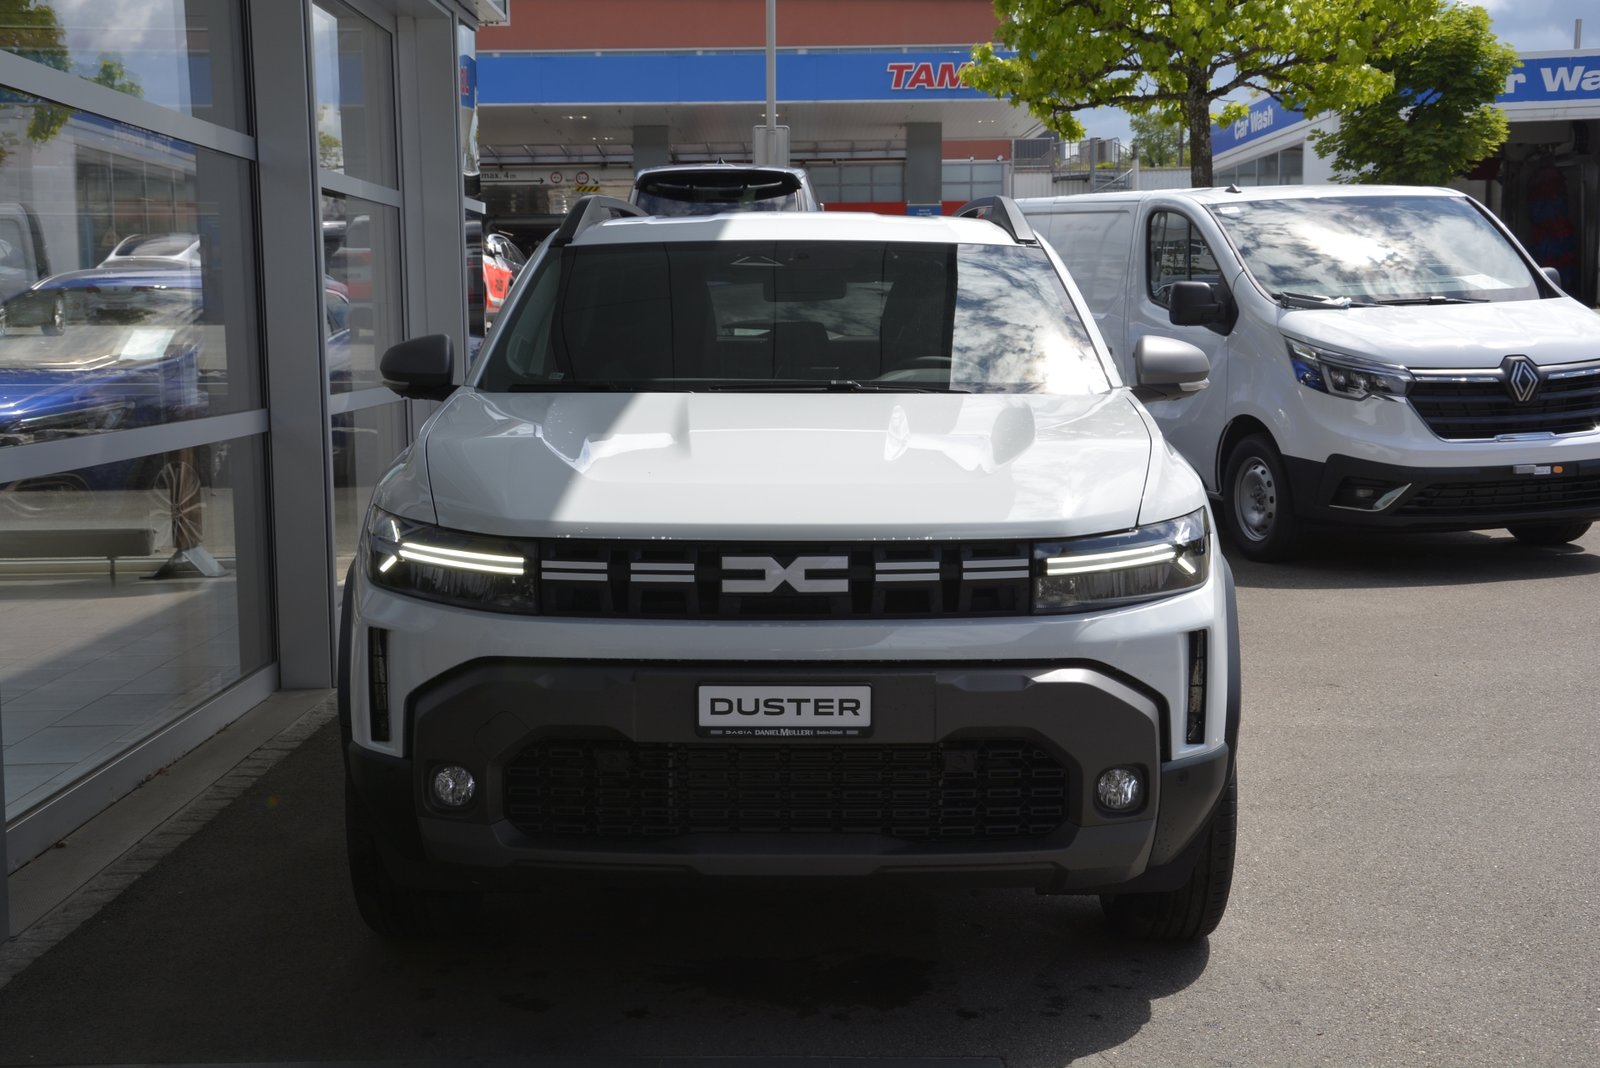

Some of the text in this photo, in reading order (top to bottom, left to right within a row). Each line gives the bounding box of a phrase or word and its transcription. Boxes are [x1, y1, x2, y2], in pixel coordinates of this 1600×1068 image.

[1234, 105, 1273, 140] Car Wash
[709, 698, 861, 716] DUSTER
